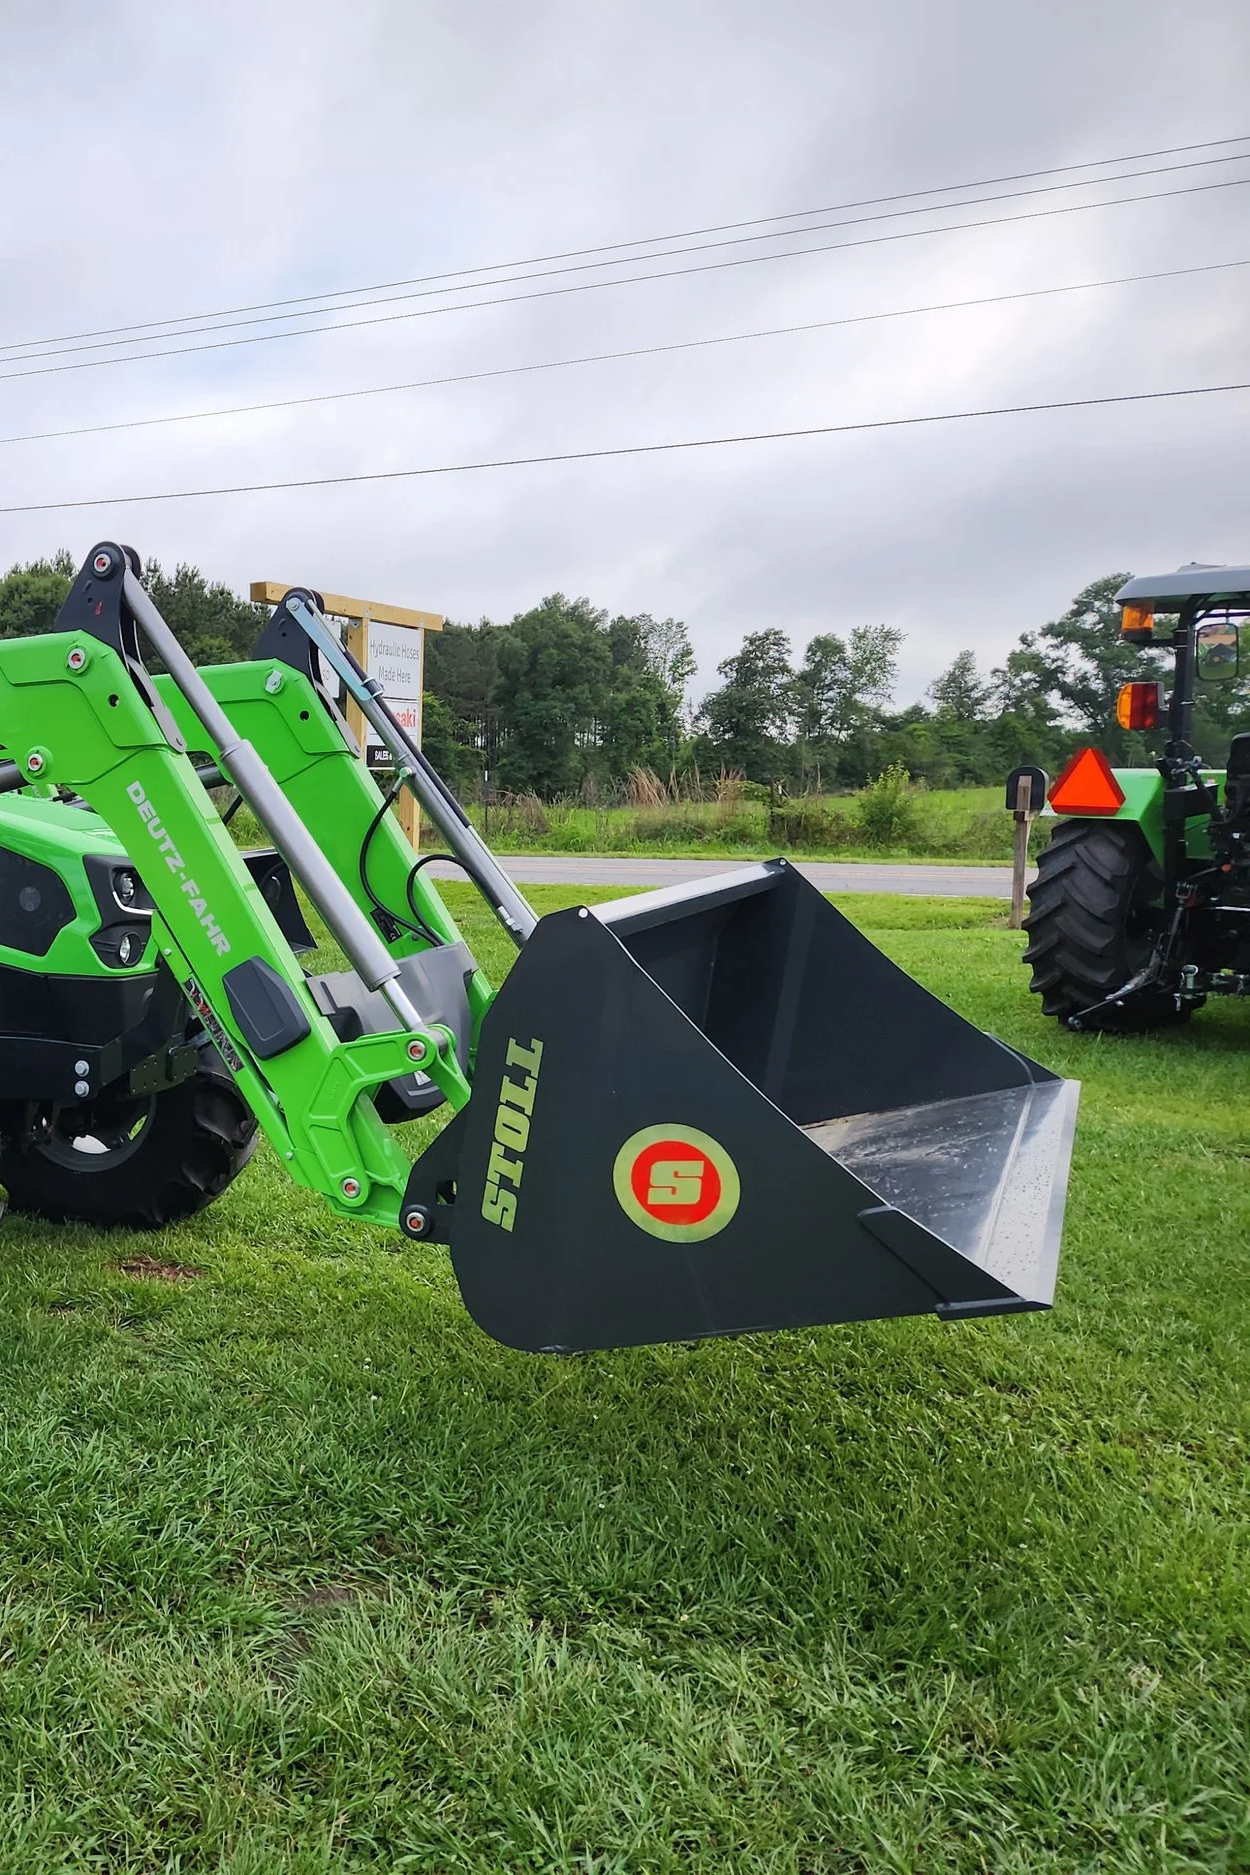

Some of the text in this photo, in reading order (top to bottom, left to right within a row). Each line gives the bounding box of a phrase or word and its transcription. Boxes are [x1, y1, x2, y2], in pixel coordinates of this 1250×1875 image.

[370, 639, 419, 660] Hydraulic Hoses
[378, 666, 411, 684] Made Here
[374, 750, 389, 761] SALES
[126, 780, 231, 957] DEUTZ-FAHR
[481, 1037, 544, 1233] STOLL
[647, 1160, 705, 1205] S
